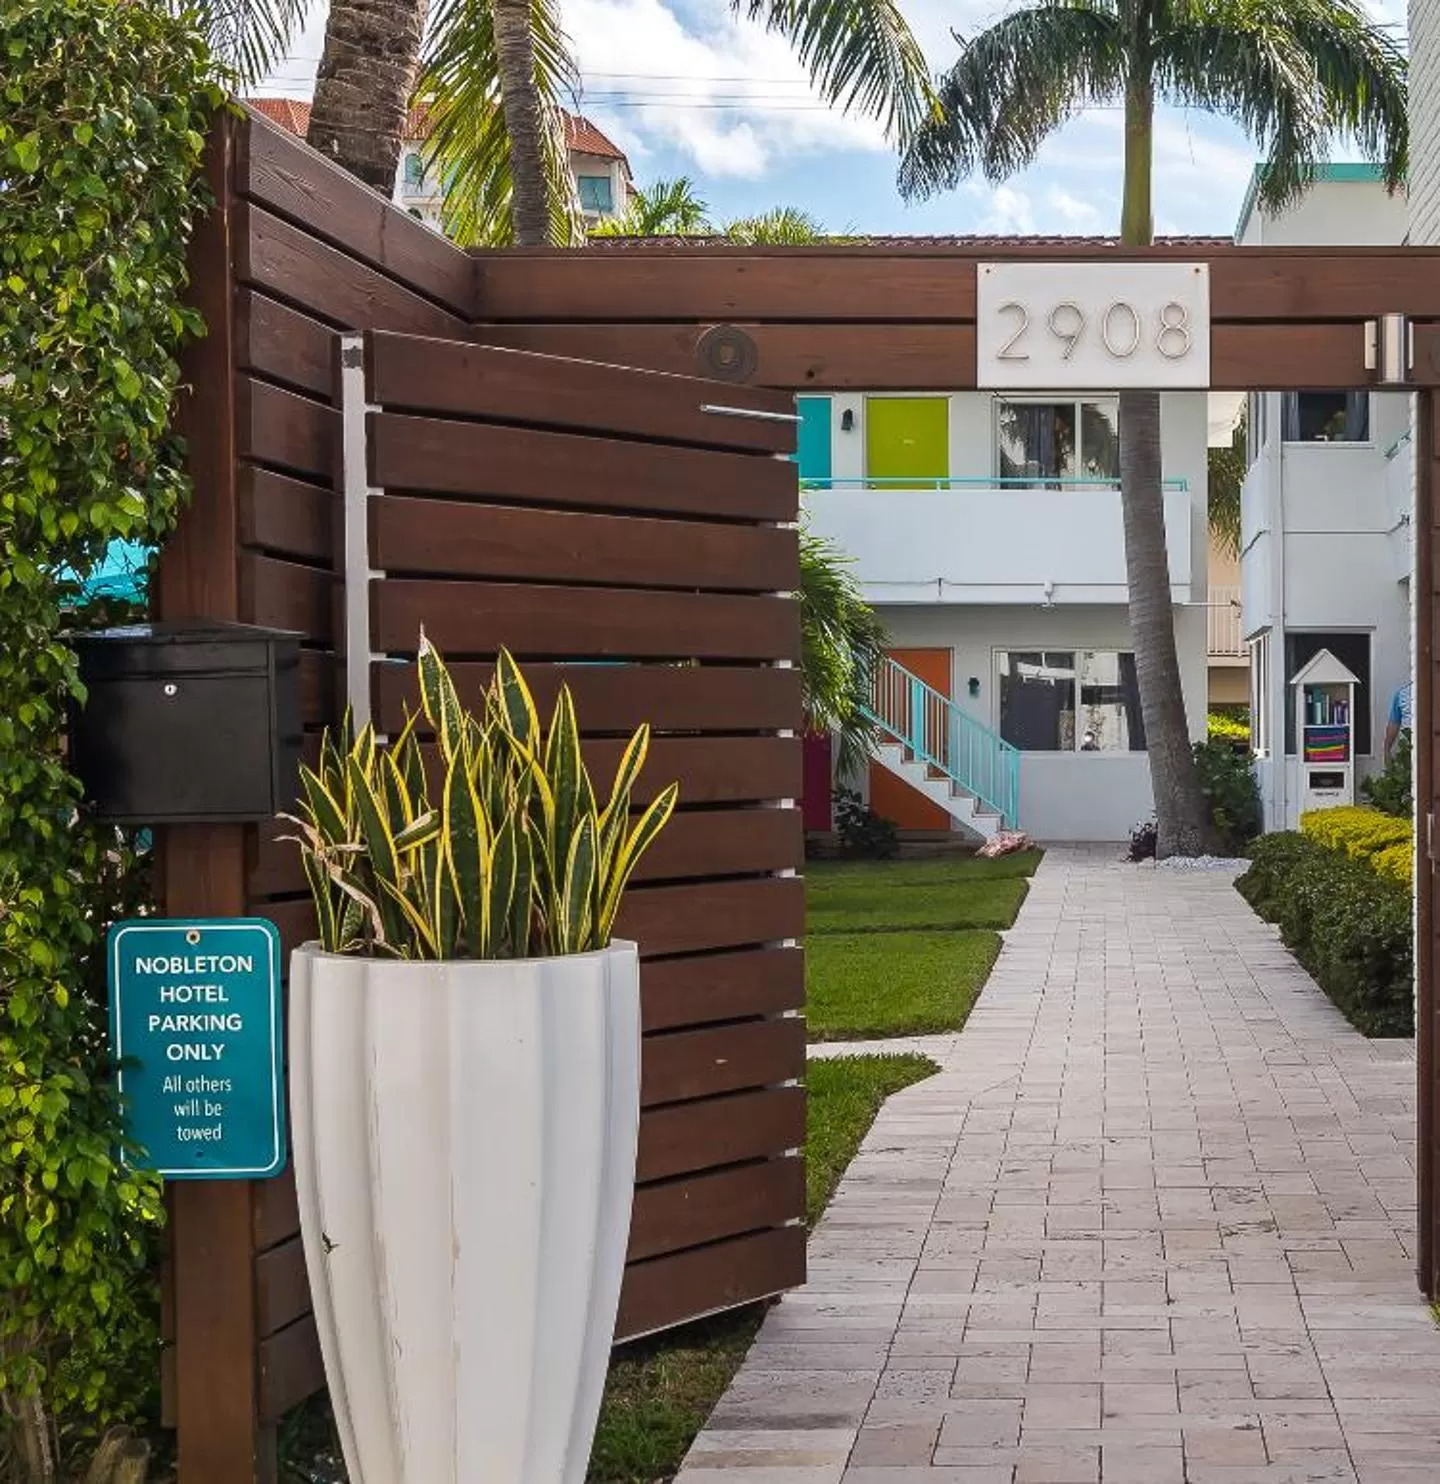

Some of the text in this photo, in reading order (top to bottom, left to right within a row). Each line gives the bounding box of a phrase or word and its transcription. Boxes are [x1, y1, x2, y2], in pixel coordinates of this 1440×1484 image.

[997, 301, 1192, 359] 2908
[135, 955, 253, 975] NOBLETON
[160, 985, 229, 1003] HOTEL
[148, 1013, 243, 1032] PARKING
[166, 1043, 225, 1062] ONLY
[162, 1075, 232, 1093] All others
[174, 1100, 222, 1116] will be
[177, 1123, 222, 1141] towed
